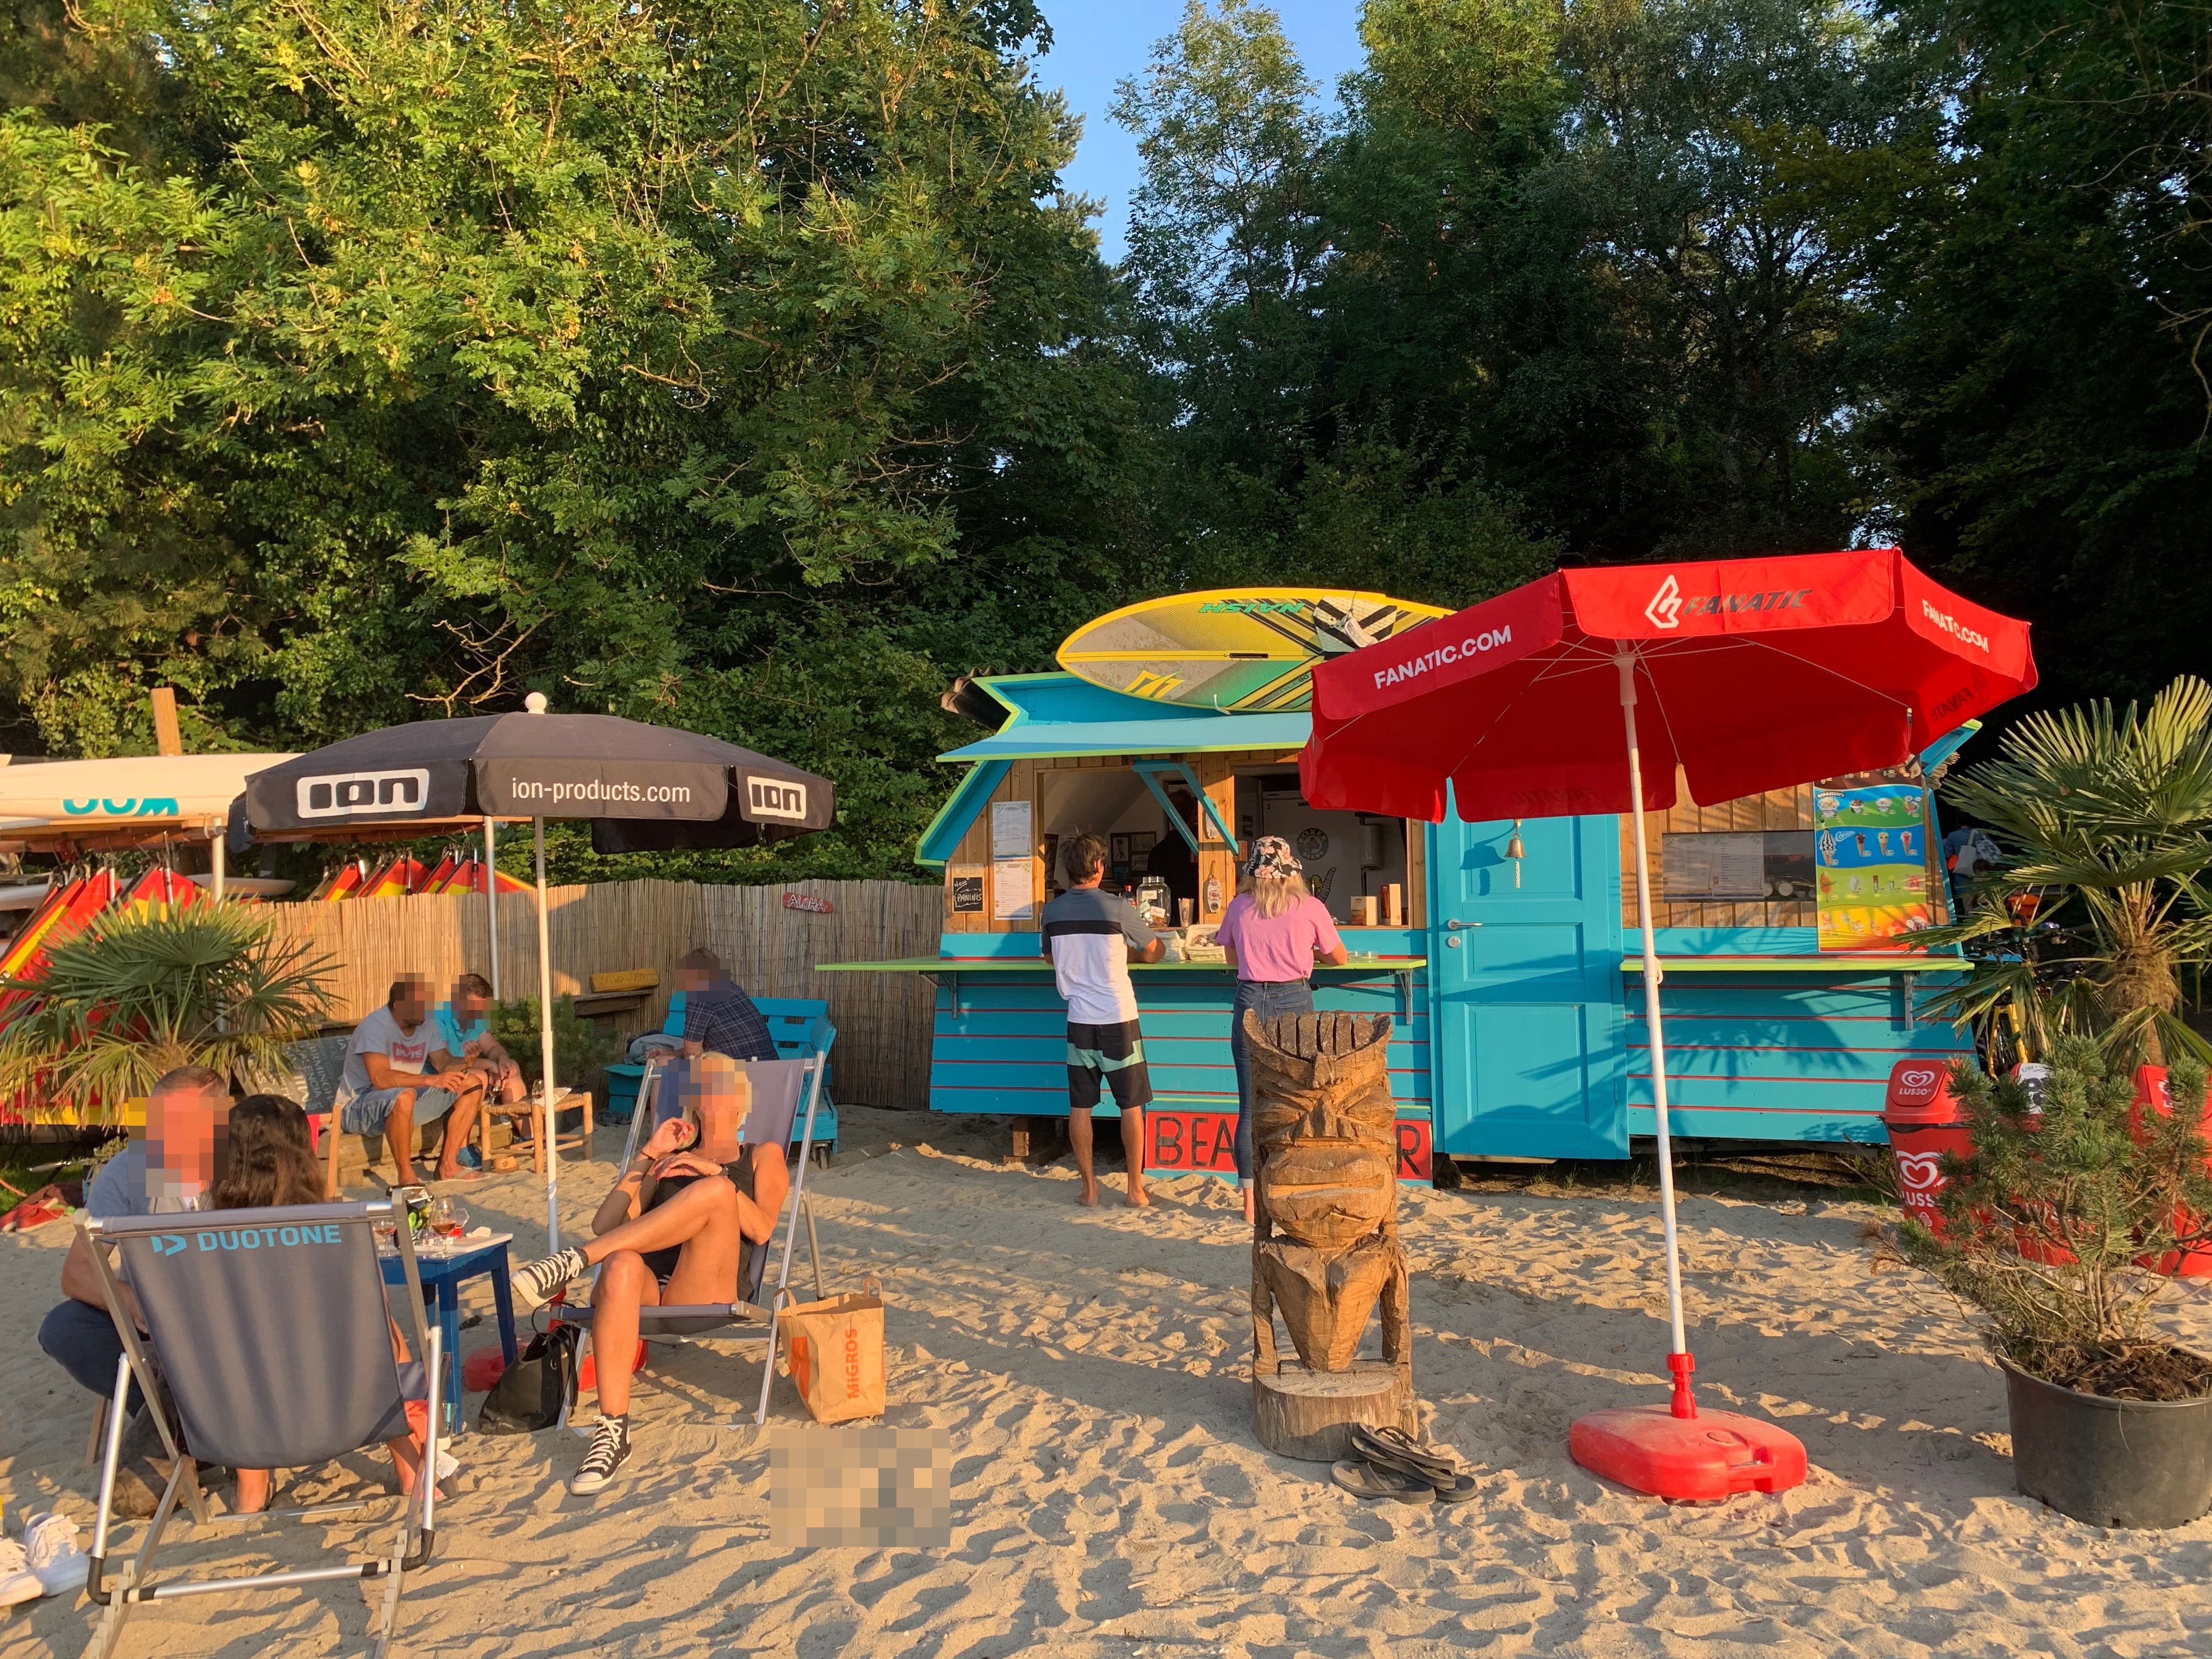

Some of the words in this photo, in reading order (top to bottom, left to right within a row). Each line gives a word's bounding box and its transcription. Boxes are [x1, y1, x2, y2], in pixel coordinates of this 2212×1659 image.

[1199, 602, 1306, 614] NAISH
[1683, 589, 1813, 616] FANATIC
[1374, 625, 1512, 690] FANATIC.COM
[512, 777, 690, 805] ion-products.com
[787, 894, 828, 913] ALOHA
[957, 892, 983, 902] PANINIS
[1898, 1087, 1928, 1096] LUSSO
[1155, 1116, 1238, 1169] BEA
[1901, 1191, 1935, 1207] LUSS
[199, 1224, 342, 1253] DUOTONE
[847, 1328, 860, 1400] MIGROS
